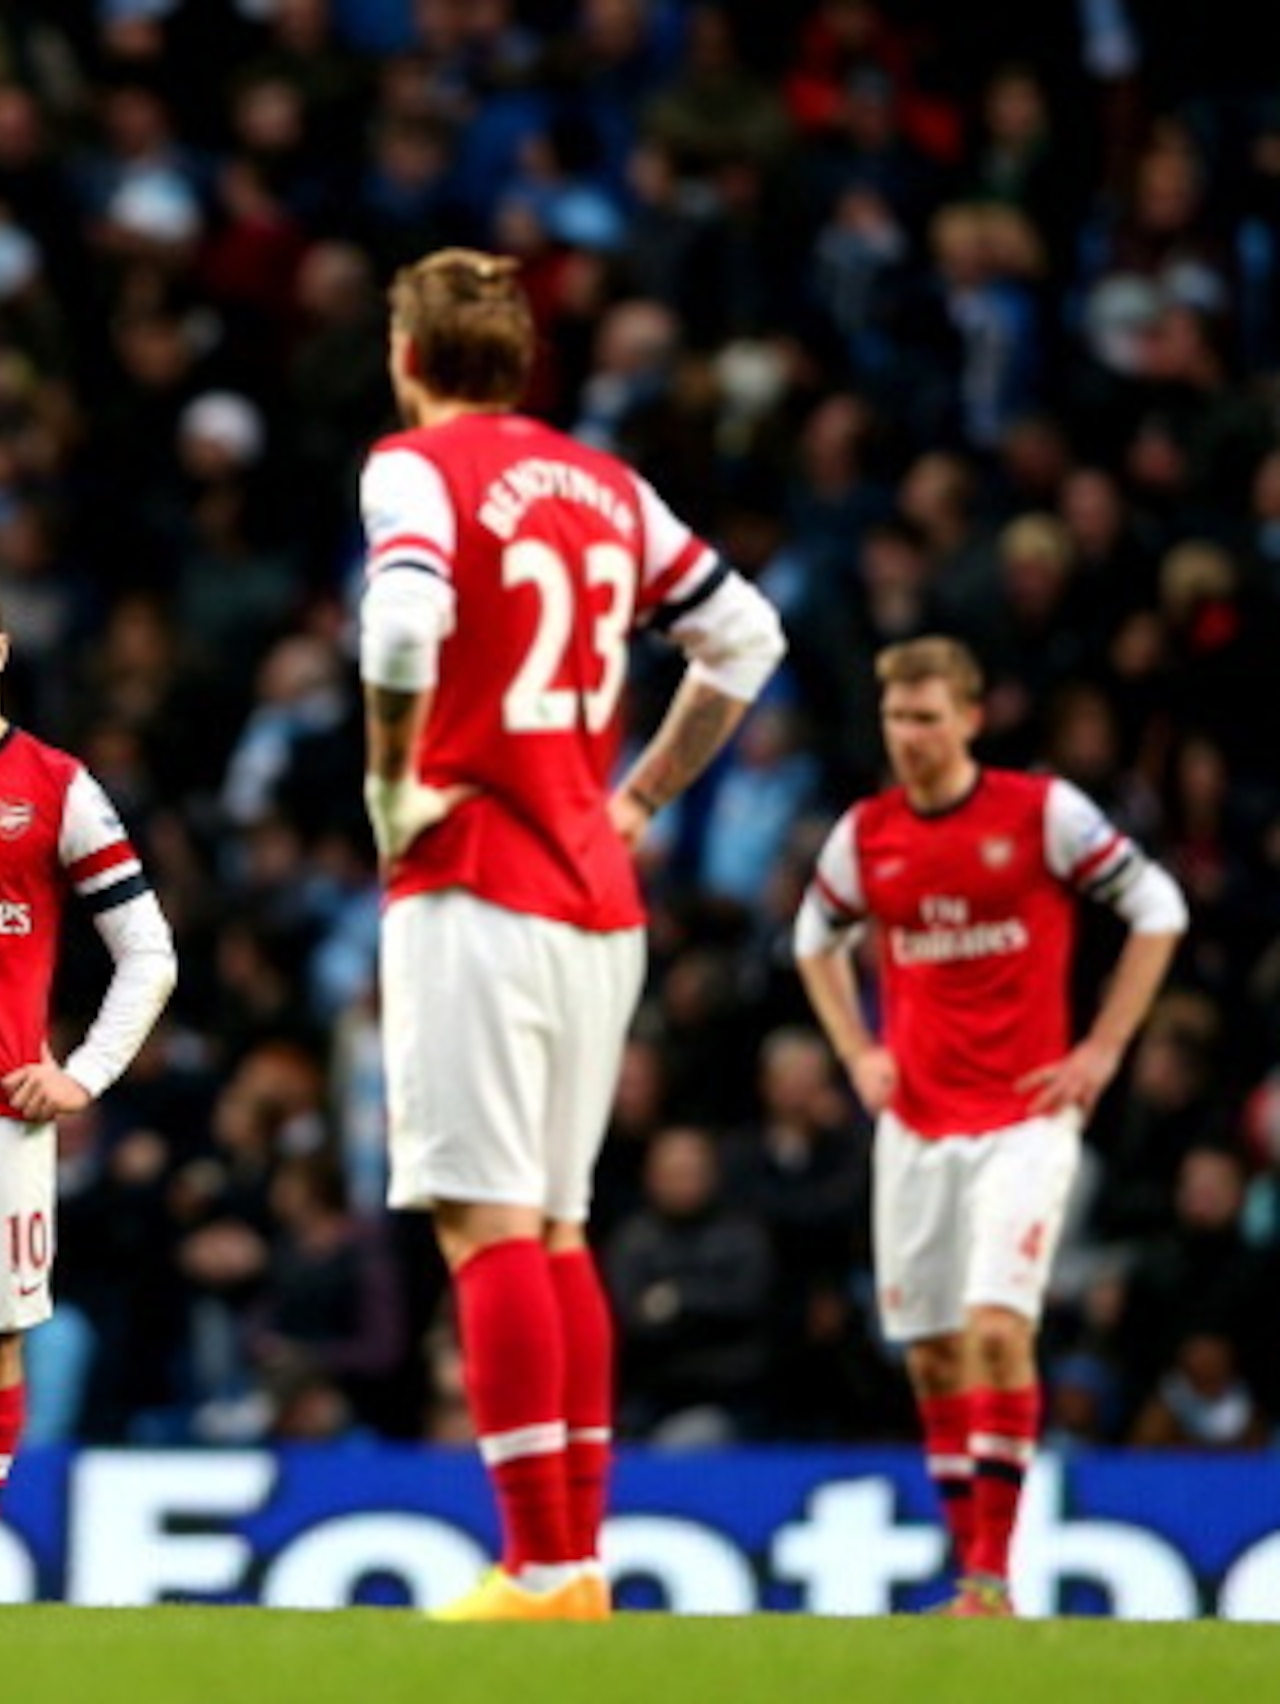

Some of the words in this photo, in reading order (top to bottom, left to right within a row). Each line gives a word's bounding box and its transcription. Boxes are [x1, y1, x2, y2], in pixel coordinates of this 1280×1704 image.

[502, 539, 638, 736] 23
[6, 1210, 49, 1272] 10
[1019, 1221, 1045, 1261] 4
